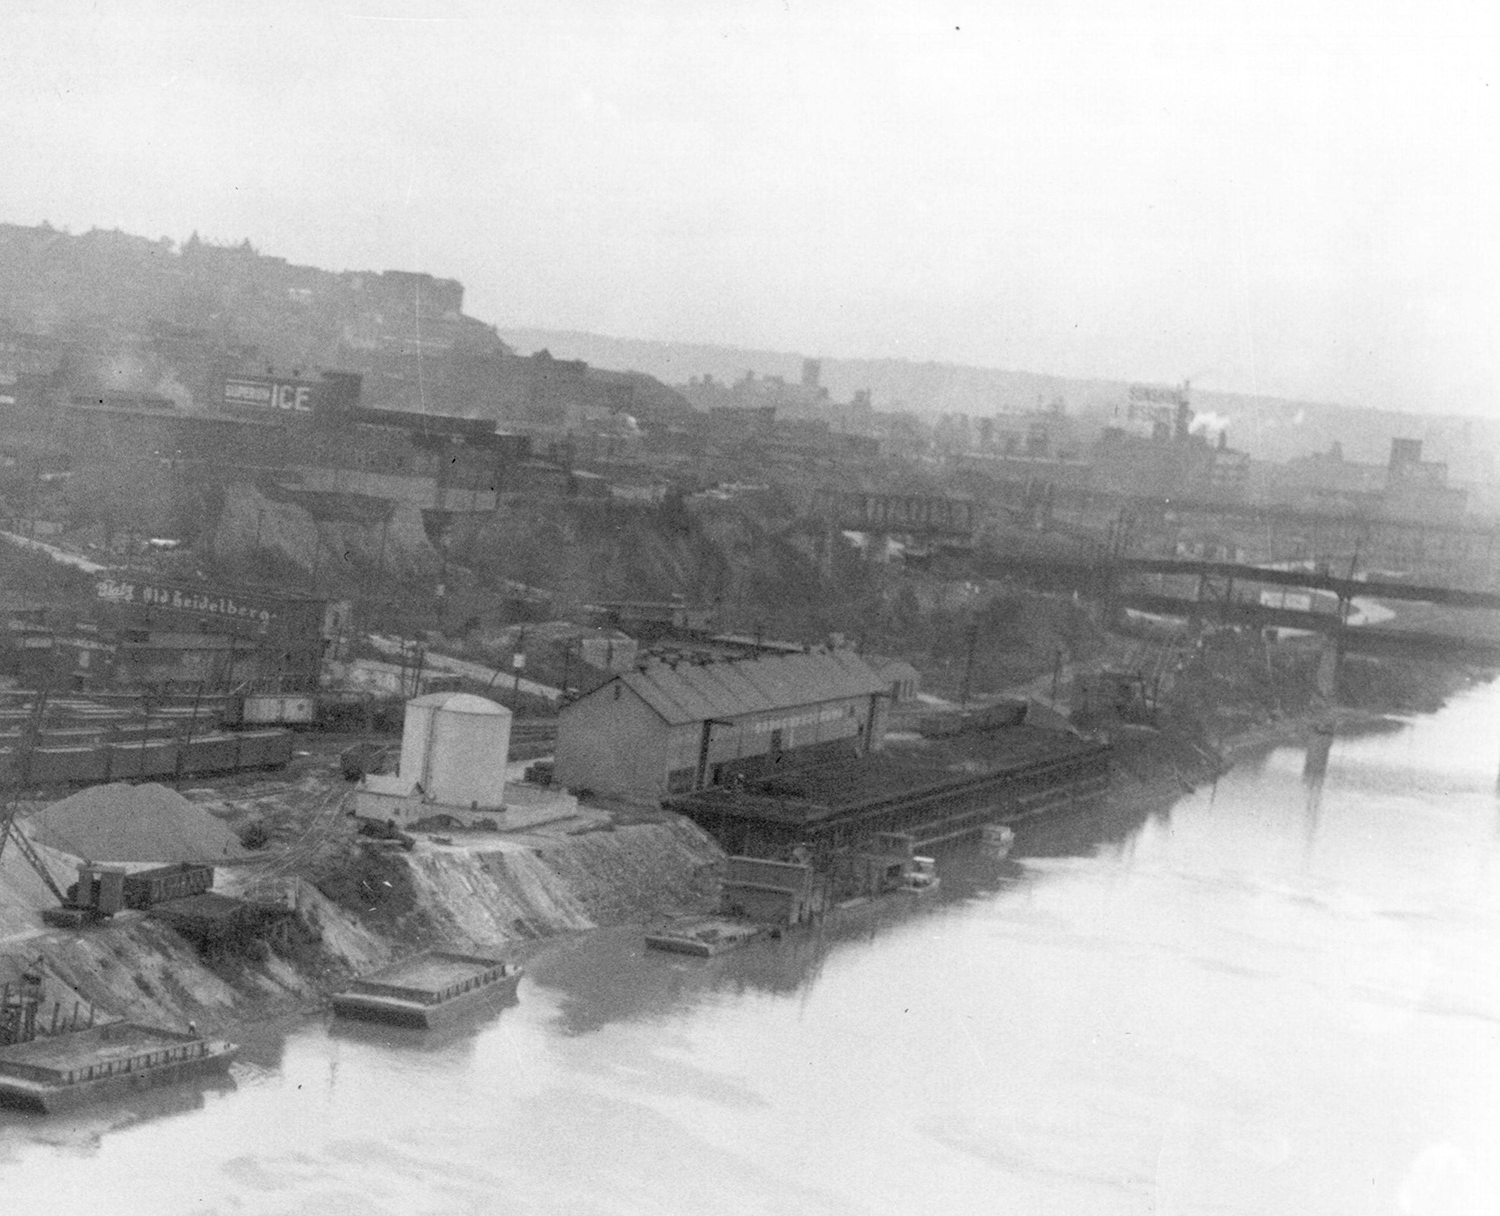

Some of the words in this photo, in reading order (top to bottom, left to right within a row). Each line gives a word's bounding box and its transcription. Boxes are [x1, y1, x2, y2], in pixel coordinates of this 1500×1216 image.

[271, 384, 312, 411] ICE
[143, 587, 169, 604] Old
[173, 591, 274, 628] Heidelberg
